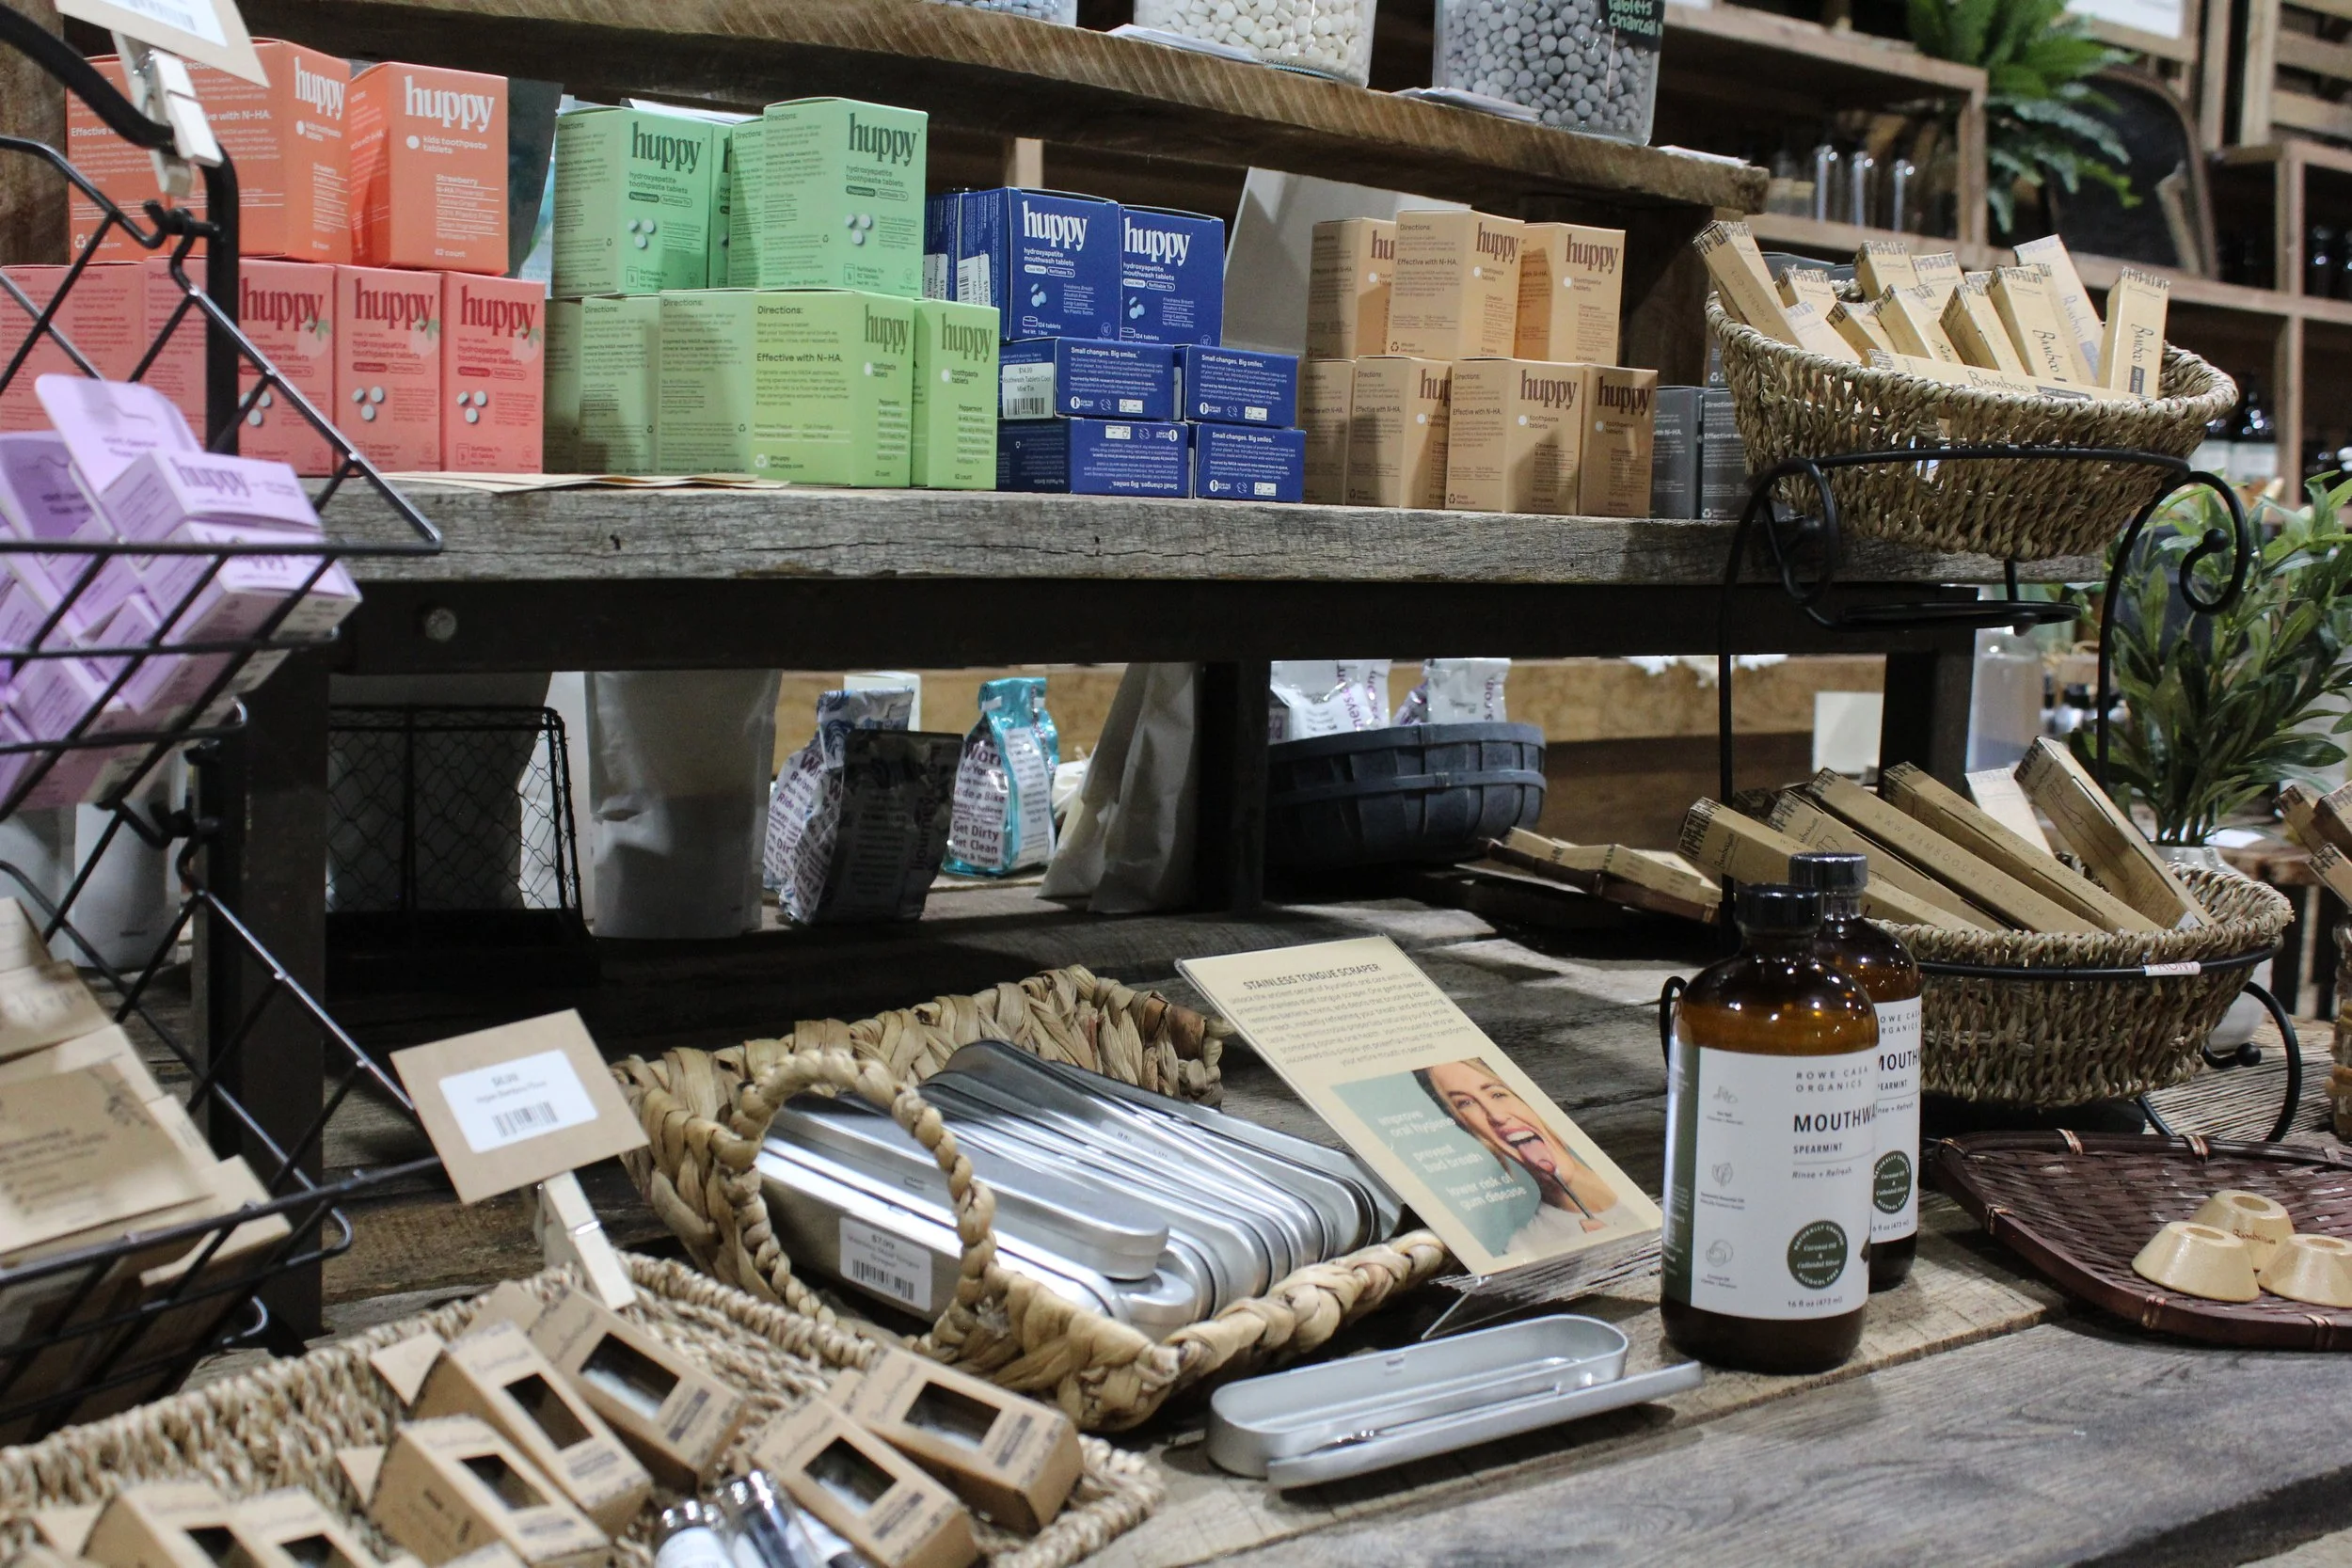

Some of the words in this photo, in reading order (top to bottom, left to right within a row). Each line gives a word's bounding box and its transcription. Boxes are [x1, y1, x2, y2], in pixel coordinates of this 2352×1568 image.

[294, 56, 345, 120] huppy
[405, 75, 494, 133] huppy
[219, 111, 240, 120] with
[71, 127, 107, 136] Effective
[849, 113, 917, 166] huppy
[423, 144, 453, 154] tablets
[442, 137, 488, 150] toothpaste
[632, 121, 701, 174] huppy
[666, 185, 688, 195] tablets
[882, 178, 904, 187] tablets
[1022, 200, 1088, 251] huppy
[1124, 217, 1191, 266] huppy
[1476, 221, 1518, 264] huppy
[1024, 247, 1063, 258] hydroxyapatite
[1025, 256, 1055, 264] mouthwash
[1565, 233, 1619, 274] huppy
[1123, 262, 1164, 274] hydroxyapatite
[1123, 269, 1154, 278] mouthwash
[1155, 273, 1174, 281] tablets
[241, 277, 323, 333] huppy
[355, 277, 434, 332] huppy
[460, 285, 536, 340] huppy
[757, 306, 803, 314] Directions:
[865, 303, 909, 356] huppy
[942, 312, 993, 363] huppy
[756, 353, 794, 362] Effective
[796, 353, 815, 361] with
[817, 354, 843, 362] N-HA.
[1216, 356, 1237, 365] changes.
[1238, 358, 1247, 367] Big
[952, 369, 978, 377] toothpaste
[1519, 369, 1577, 410] huppy
[1598, 376, 1650, 417] huppy
[1529, 415, 1559, 423] toothpaste
[953, 821, 968, 832] Get
[971, 826, 999, 843] Dirty
[952, 835, 967, 847] Get
[971, 840, 997, 854] Clean
[1243, 974, 1297, 990] STAINLESS
[1298, 970, 1337, 984] TONGUE
[1338, 964, 1381, 978] SCRAPER
[1881, 1014, 1901, 1023] OWE
[1882, 1022, 1917, 1034] RGANICS
[1796, 1071, 1836, 1080] ROWE
[1844, 1067, 1867, 1077] CASA
[1795, 1080, 1862, 1092] ORGANICS
[1378, 1110, 1423, 1127] improve
[1793, 1101, 1877, 1132] MOUTHWA
[1390, 1123, 1413, 1138] oral
[1413, 1144, 1455, 1163] prevent
[1793, 1142, 1842, 1155] SPEARMINT
[1423, 1159, 1447, 1173] bad
[1448, 1152, 1483, 1168] breath
[1792, 1170, 1816, 1180] Rinse
[1826, 1167, 1851, 1176] Refresh
[1446, 1181, 1478, 1196] lower
[1480, 1177, 1501, 1190] risk
[1502, 1174, 1513, 1185] of
[1460, 1197, 1486, 1212] gum
[1486, 1186, 1527, 1204] disease
[1878, 1199, 1898, 1210] ALCOHOL
[1899, 1194, 1907, 1206] FREE
[1794, 1225, 1824, 1250] NATURALLY
[1804, 1243, 1827, 1252] Coconut
[1799, 1273, 1825, 1285] ALCOHOL
[1826, 1269, 1839, 1282] FREE
